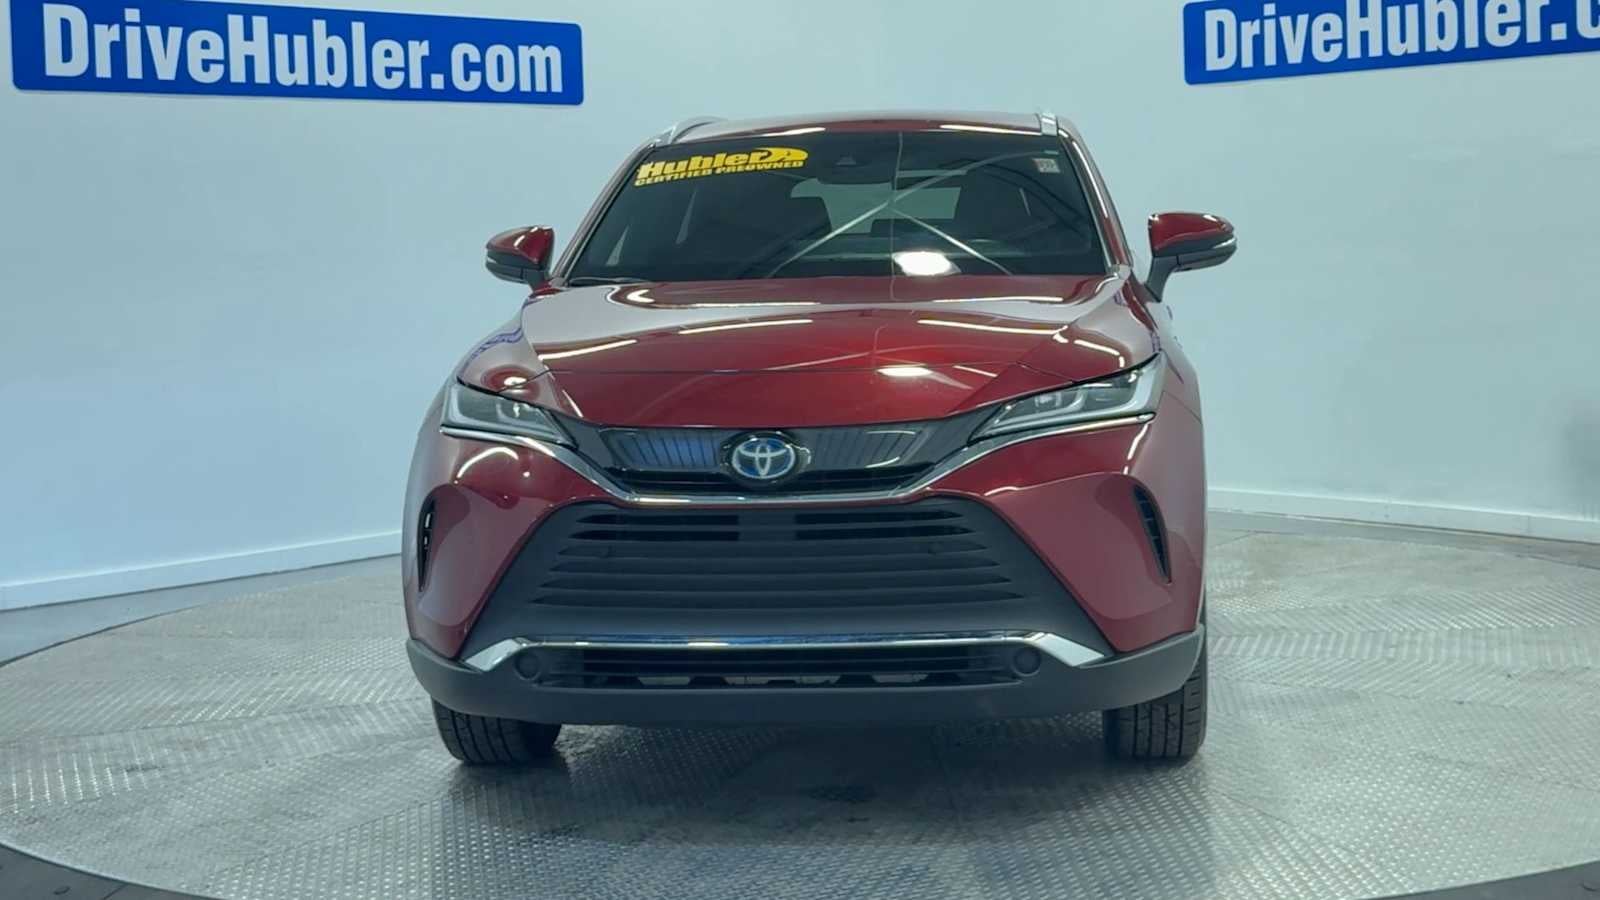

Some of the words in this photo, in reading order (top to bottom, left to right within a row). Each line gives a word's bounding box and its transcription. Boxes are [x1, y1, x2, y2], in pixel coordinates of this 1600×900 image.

[43, 3, 563, 93] DriveHubler.com
[634, 168, 713, 187] CERTIFIED
[715, 160, 804, 175] PREOWNED
[636, 151, 769, 179] Hubler
